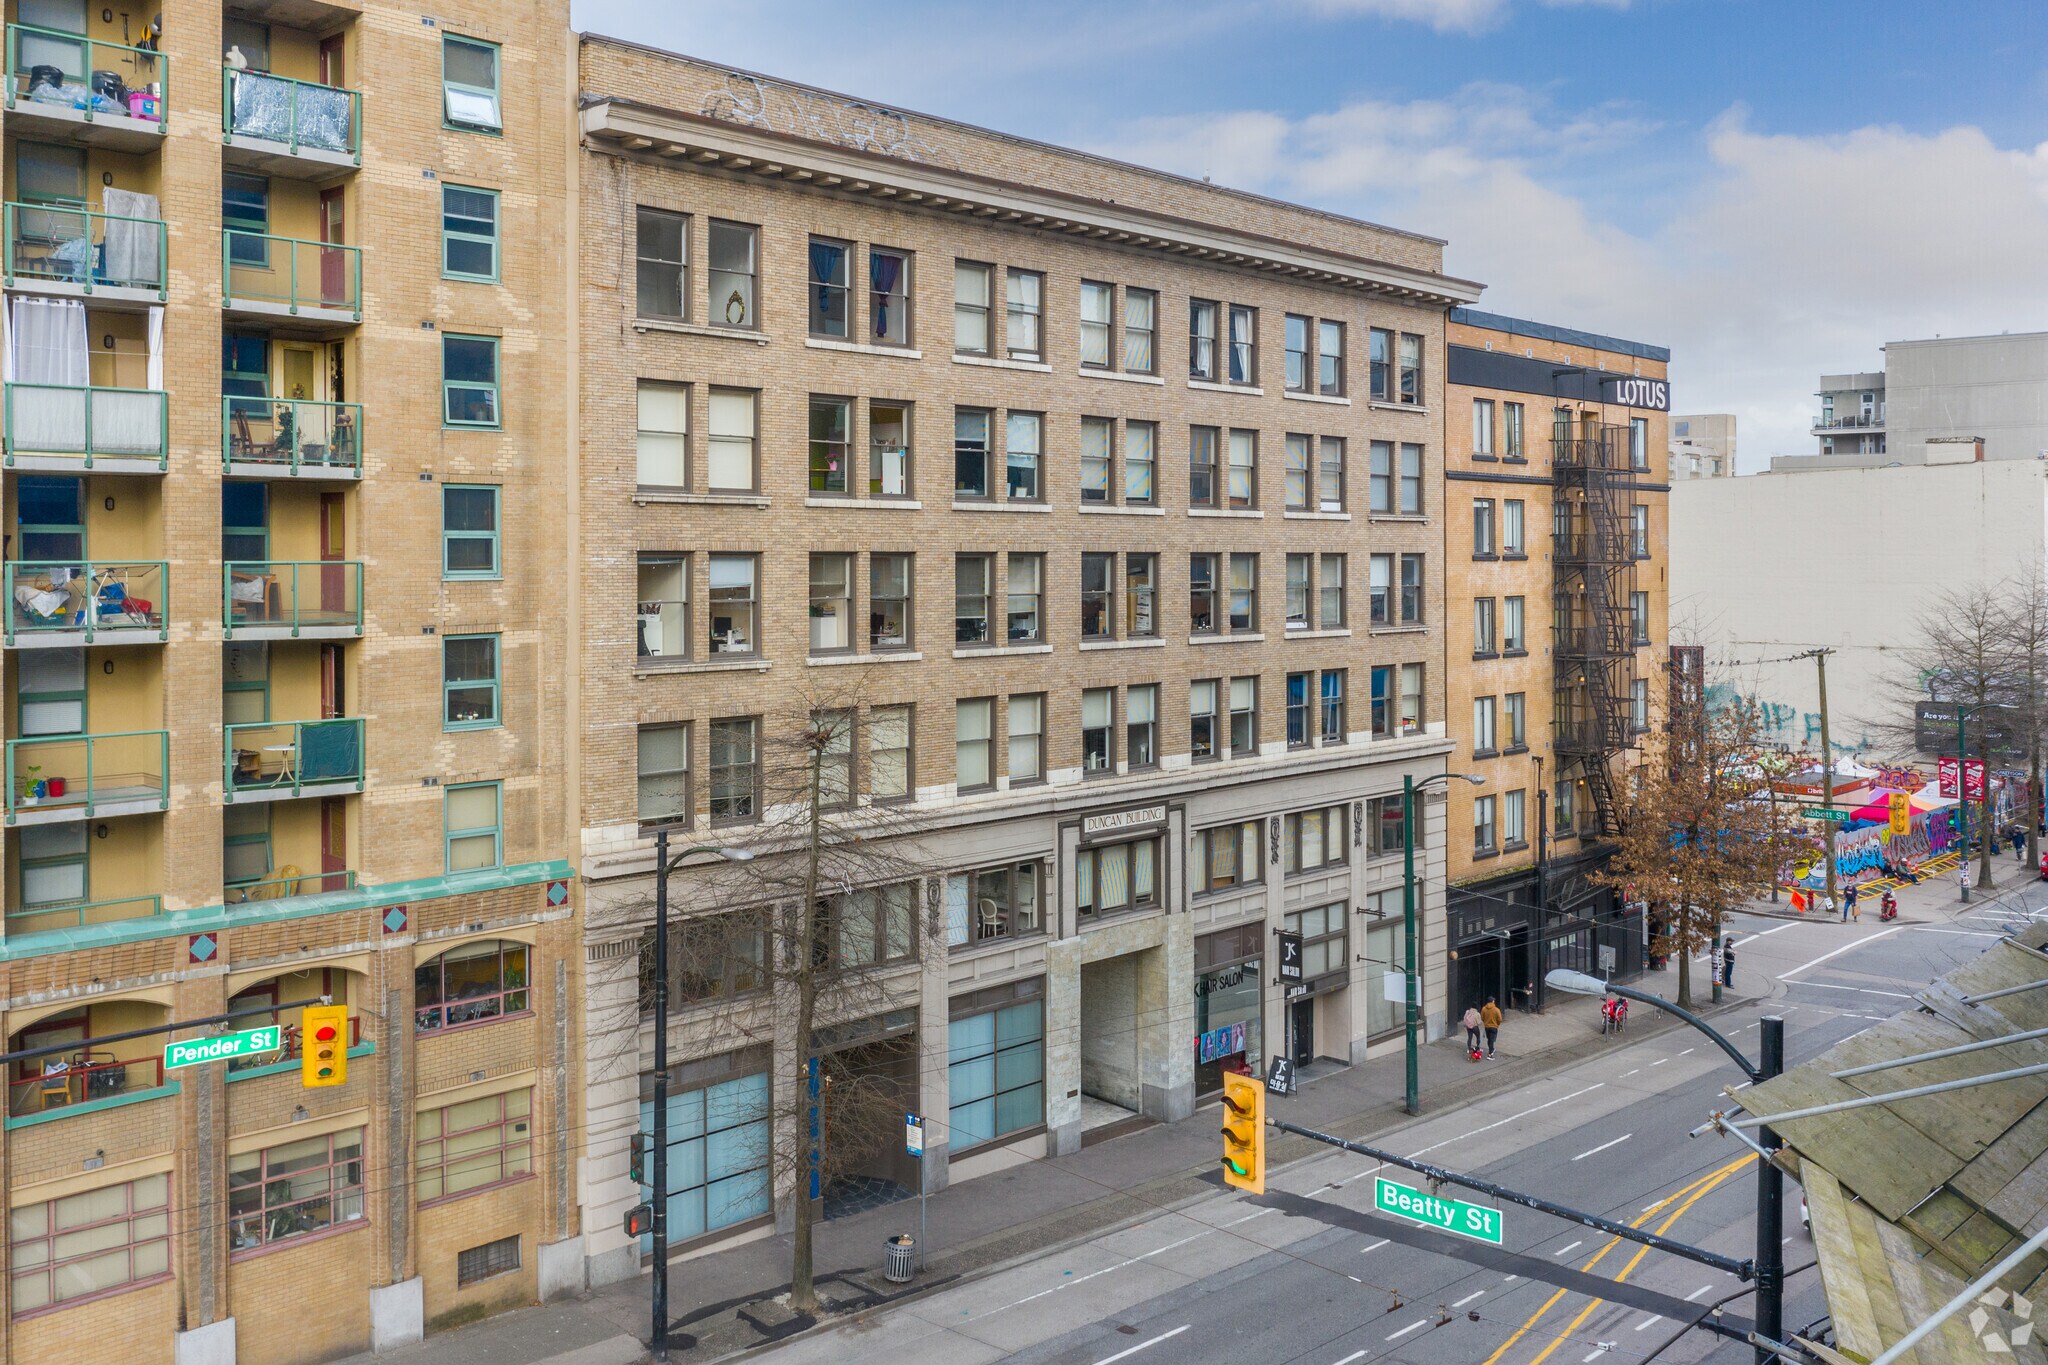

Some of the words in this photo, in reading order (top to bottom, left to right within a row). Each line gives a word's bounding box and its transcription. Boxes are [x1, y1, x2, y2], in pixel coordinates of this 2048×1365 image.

[1616, 380, 1666, 409] LOTUS
[1088, 814, 1122, 830] DUNCAN
[1126, 808, 1161, 825] BUILDING
[1804, 808, 1832, 819] Abbott
[1836, 812, 1845, 820] St
[1285, 942, 1296, 961] JK
[1200, 978, 1218, 996] HAIR
[1219, 970, 1244, 990] SALON
[172, 1039, 242, 1063] Pender
[249, 1032, 272, 1050] St
[1383, 1183, 1456, 1226] Beatty
[1466, 1209, 1492, 1234] St
